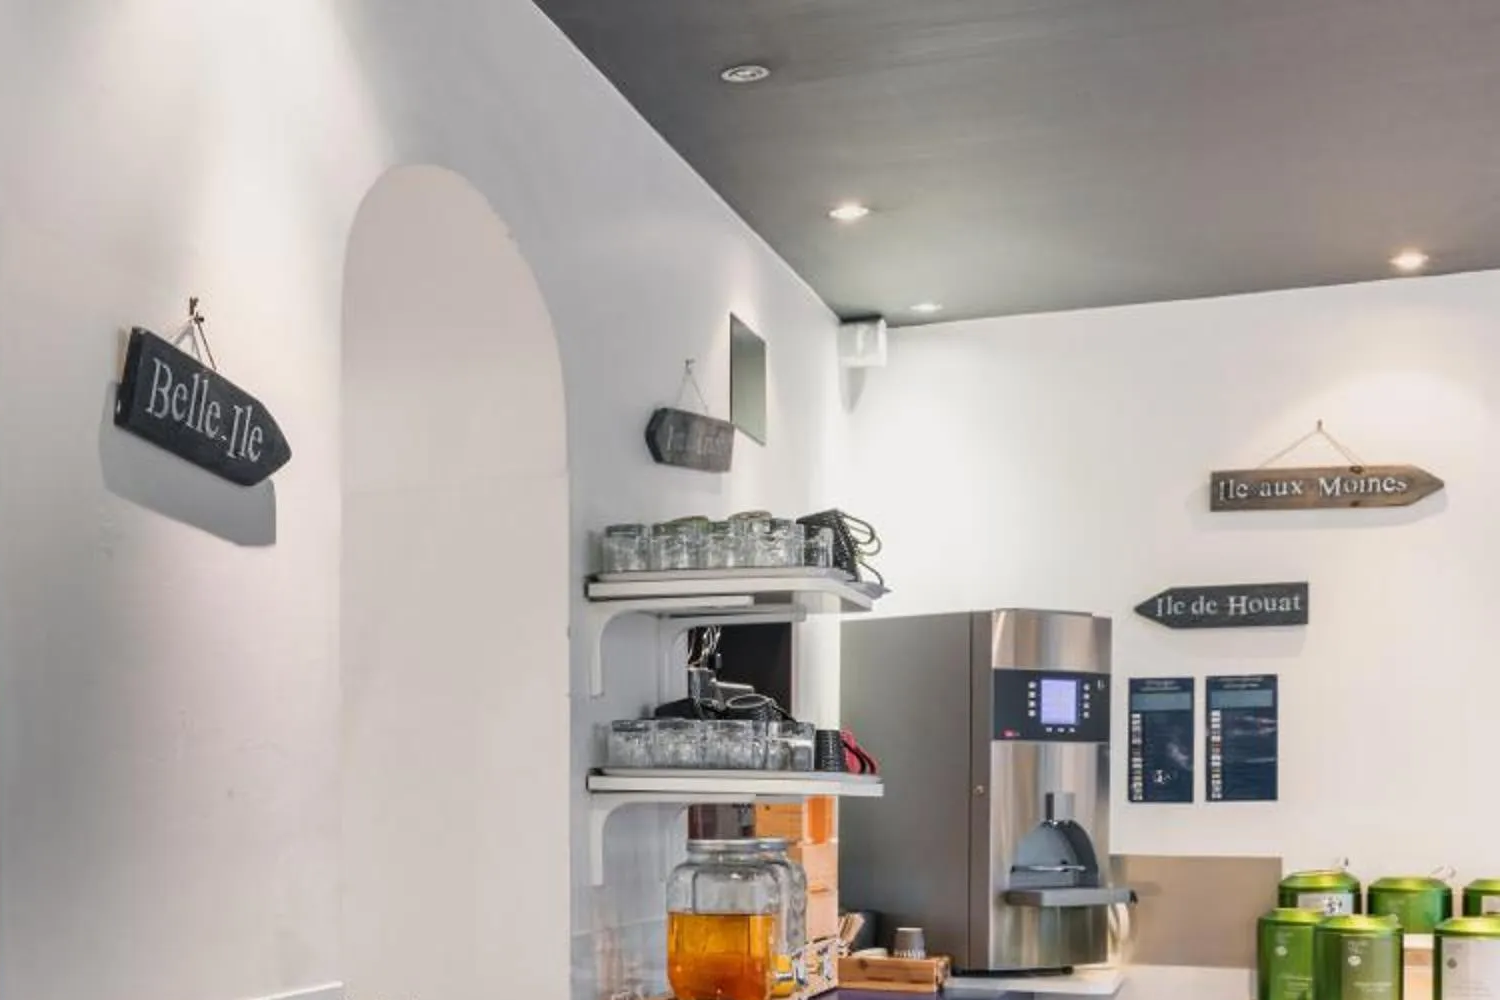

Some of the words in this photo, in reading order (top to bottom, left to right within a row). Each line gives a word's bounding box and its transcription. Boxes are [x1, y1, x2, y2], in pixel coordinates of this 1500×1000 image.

[1218, 478, 1249, 502] Ile
[1259, 478, 1304, 498] aux
[1318, 474, 1409, 498] Moines
[1154, 596, 1186, 618] Ile
[1191, 594, 1218, 616] de
[1227, 594, 1302, 617] Houat
